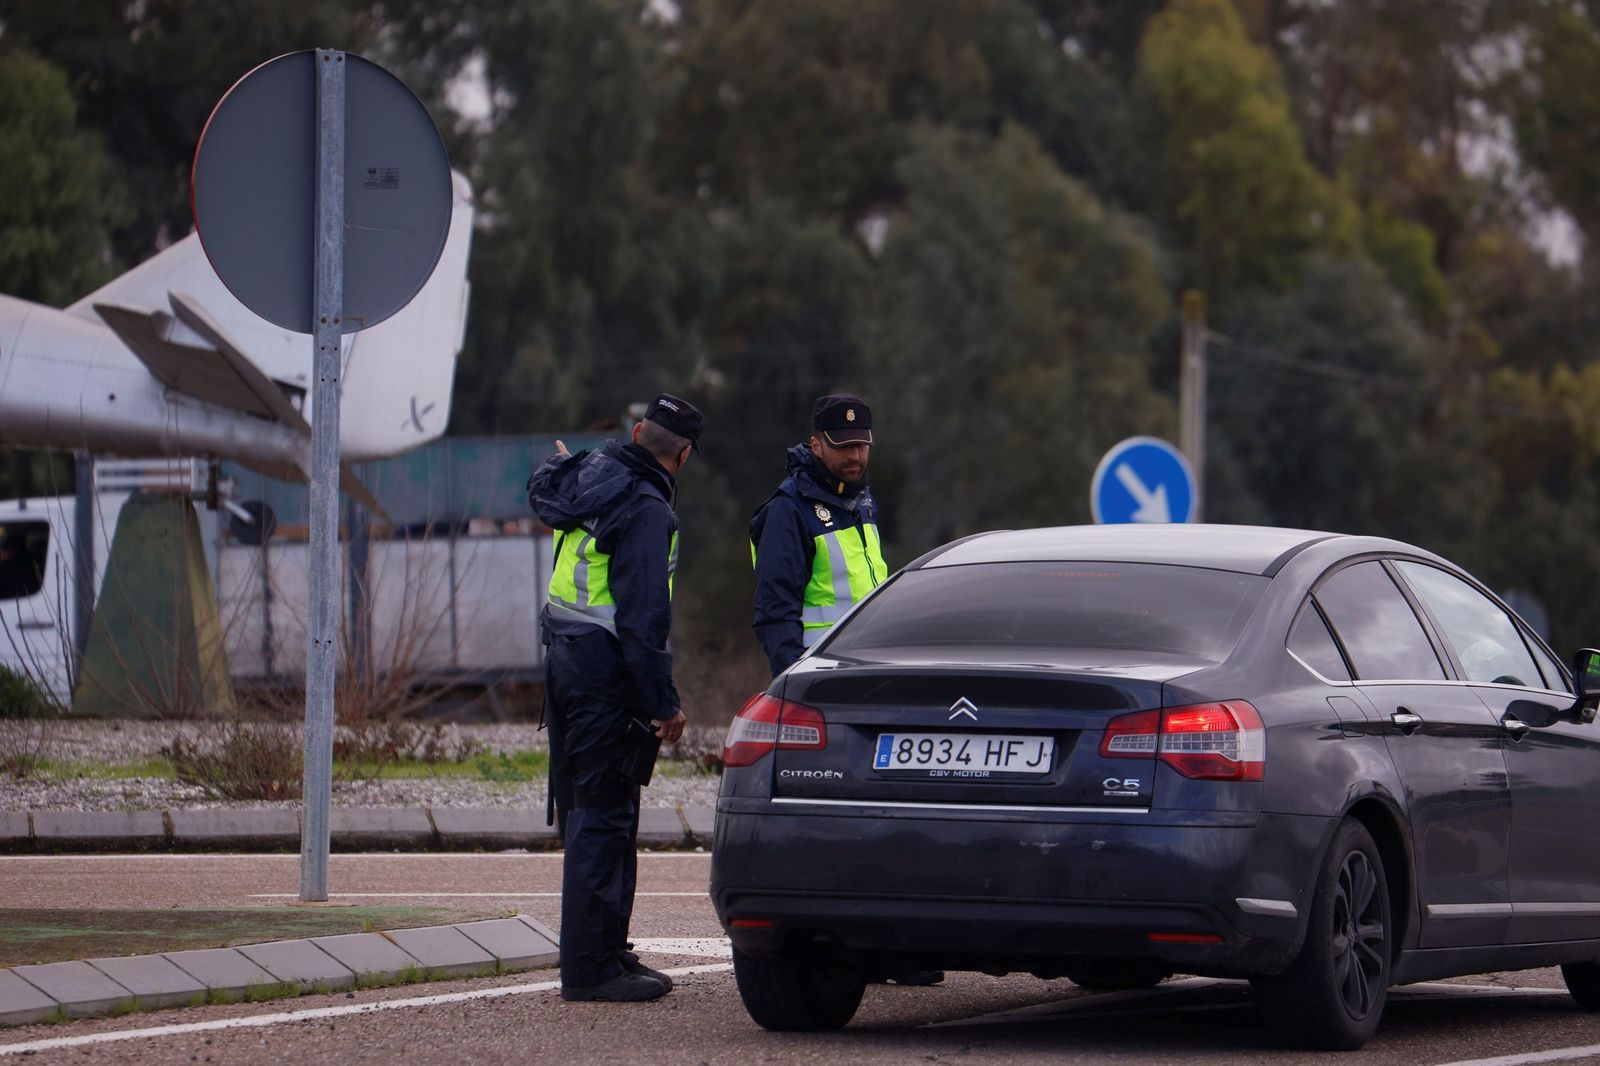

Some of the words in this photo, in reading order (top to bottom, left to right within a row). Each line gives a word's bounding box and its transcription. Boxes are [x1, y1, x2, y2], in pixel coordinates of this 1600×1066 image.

[897, 738, 972, 766] 8934
[984, 740, 1045, 767] HFJ
[879, 754, 887, 763] E
[779, 769, 844, 780] CITROËN
[952, 770, 991, 778] MOTOR
[1102, 777, 1141, 791] C5
